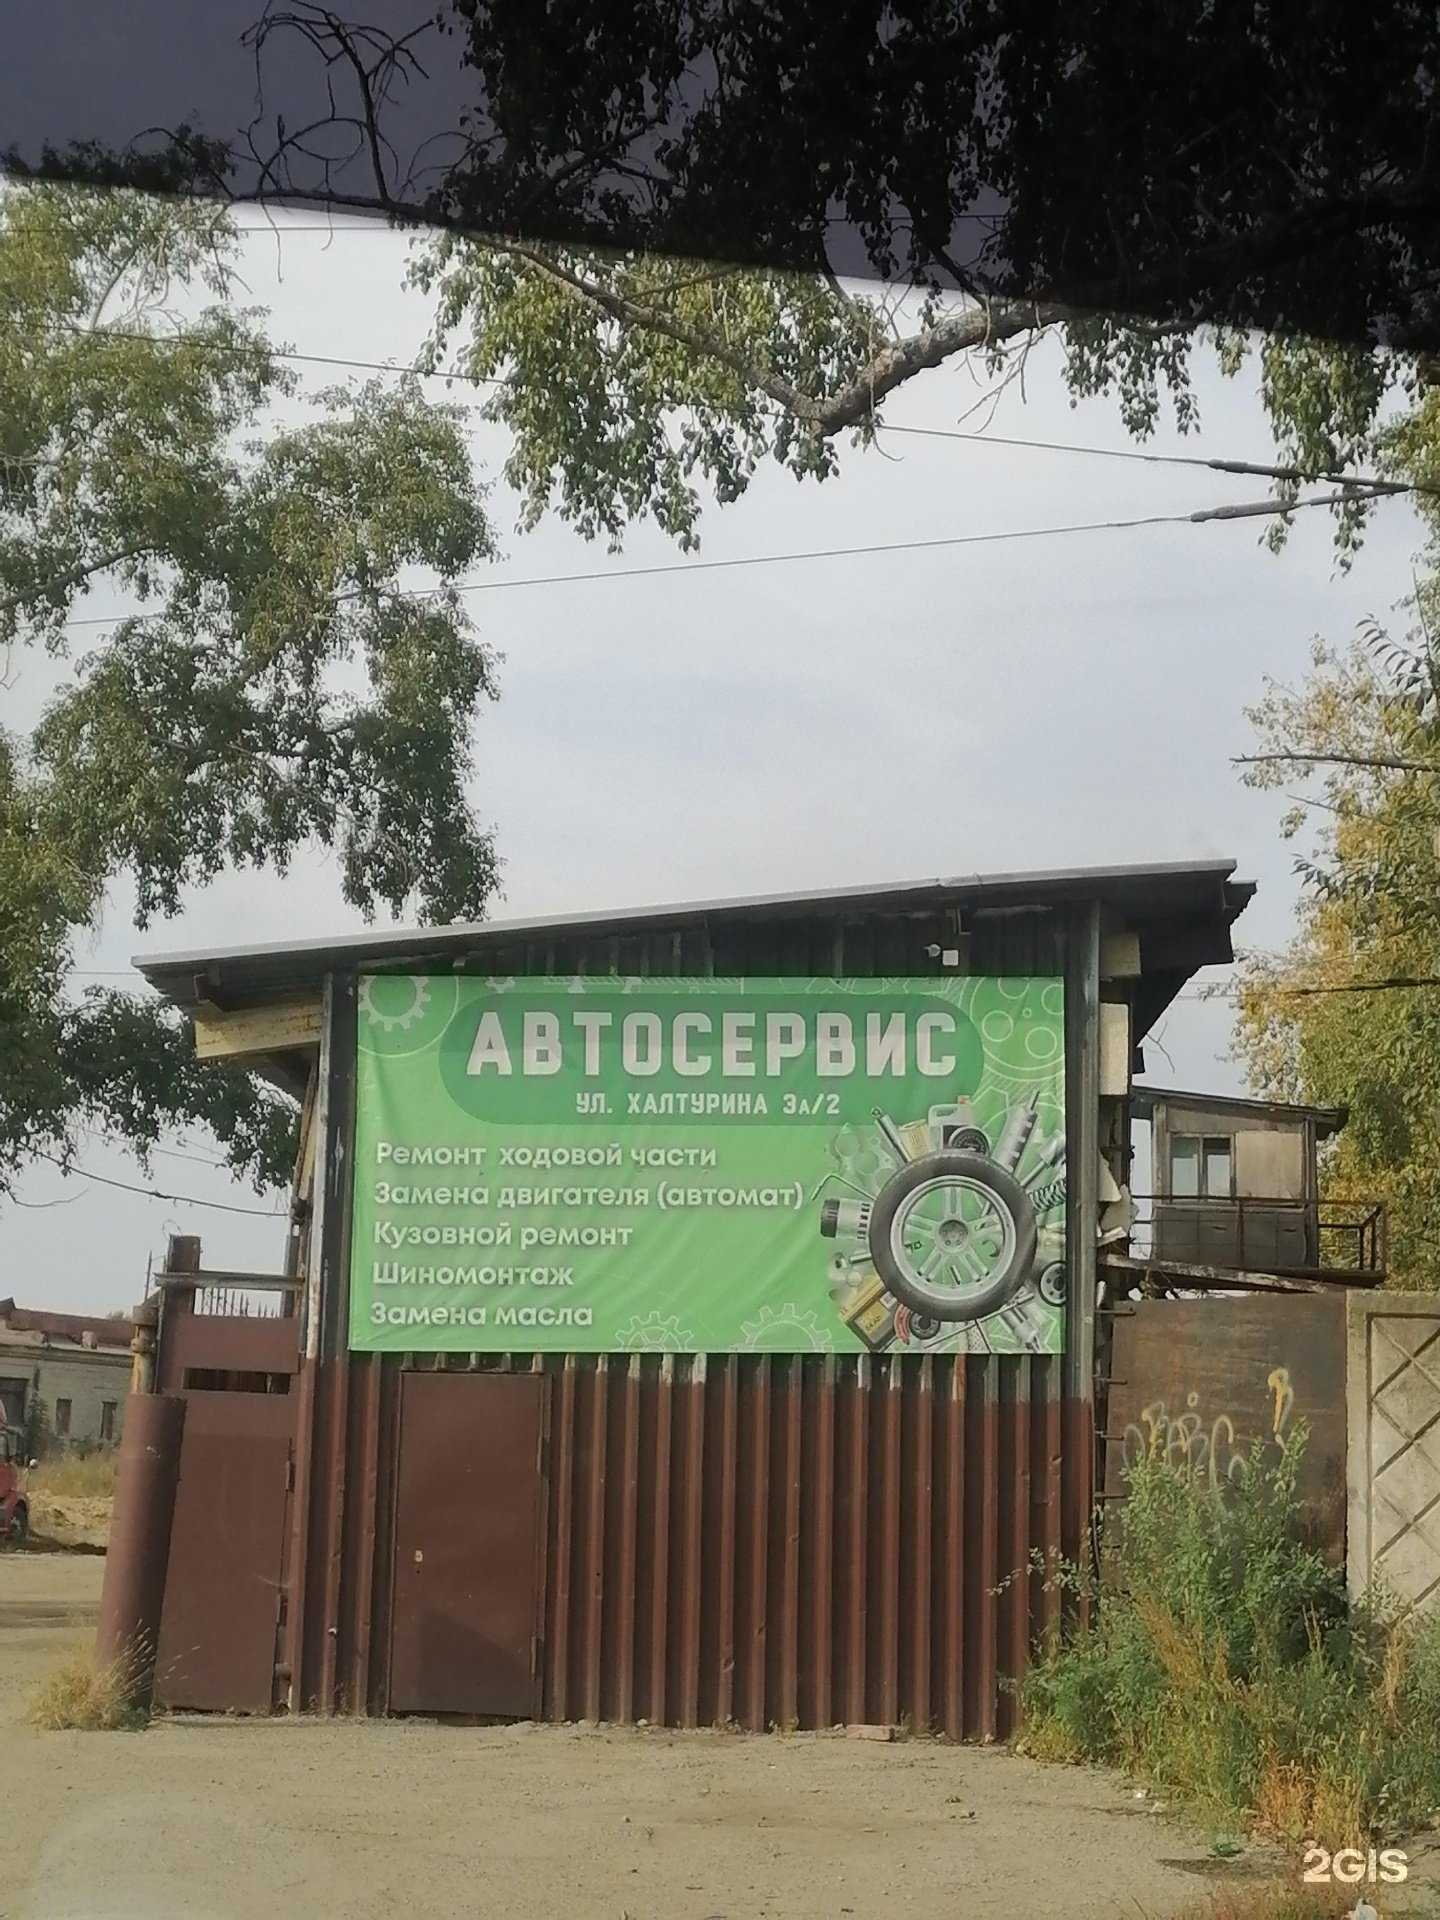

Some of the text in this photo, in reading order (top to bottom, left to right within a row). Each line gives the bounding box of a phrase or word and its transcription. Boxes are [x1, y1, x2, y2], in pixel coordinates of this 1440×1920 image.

[466, 1011, 956, 1077] АВТОСЕРВИС
[575, 1092, 613, 1114] УЛ.
[627, 1092, 768, 1115] ХАЛТУРИНА
[376, 1141, 717, 1168] Ремонт ходовой части
[374, 1180, 804, 1210] Замена двигателя (автомат)
[374, 1221, 633, 1250] Кузовной ремонт
[372, 1261, 574, 1285] Шиномонтаж
[370, 1301, 593, 1326] Замена масла
